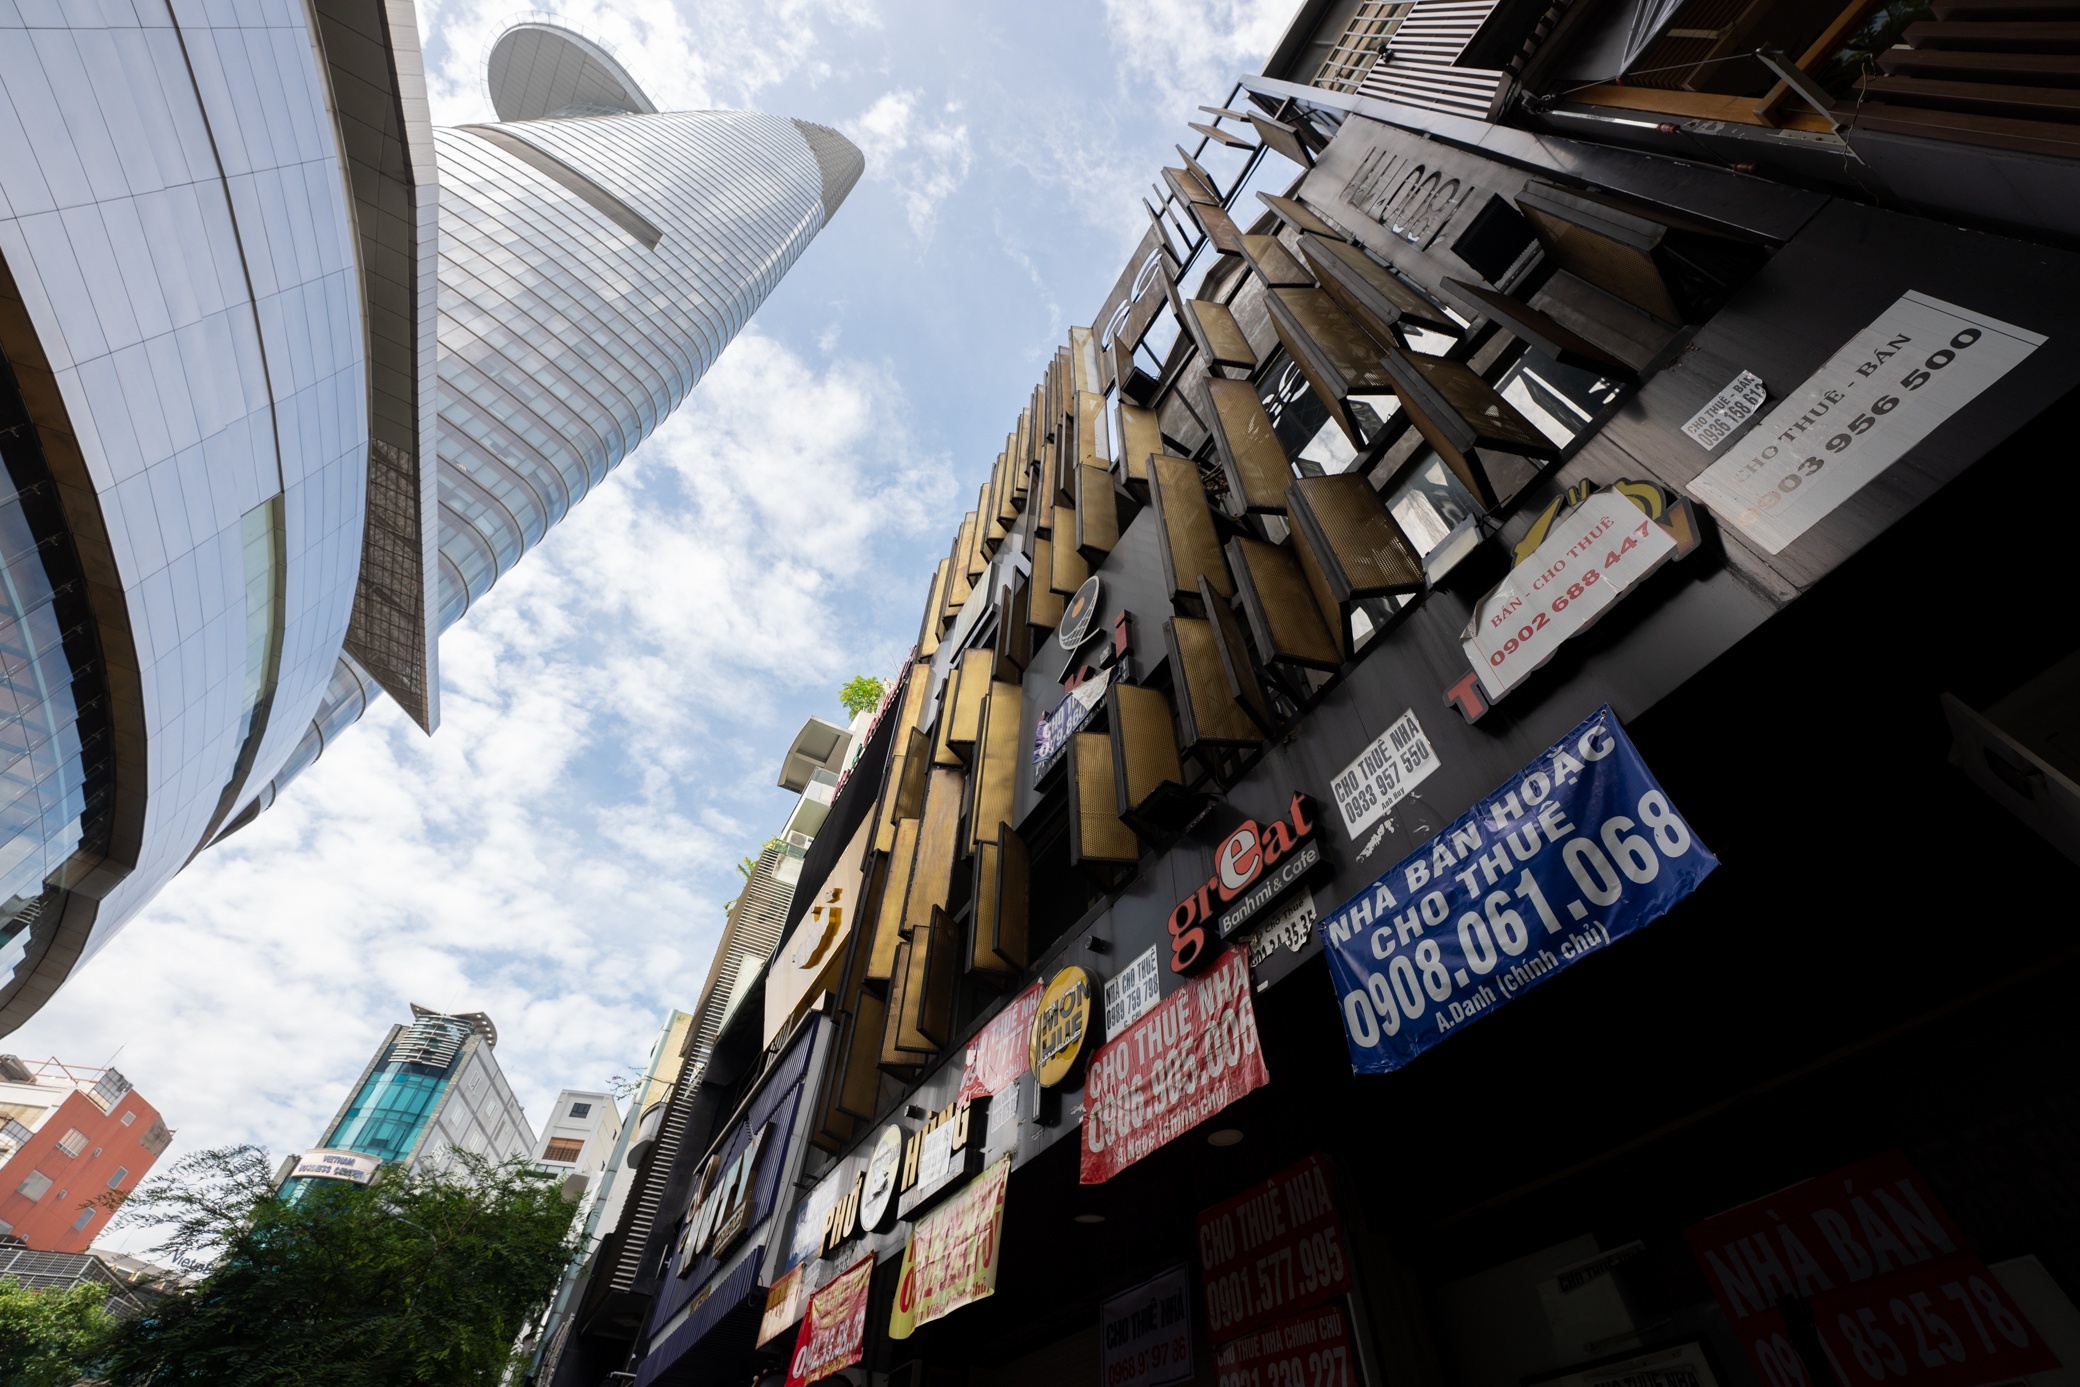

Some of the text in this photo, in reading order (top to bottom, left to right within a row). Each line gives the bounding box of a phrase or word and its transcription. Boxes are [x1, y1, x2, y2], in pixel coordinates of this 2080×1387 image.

[1698, 419, 1731, 446] 0936
[1724, 401, 1751, 423] 168
[1705, 396, 1730, 418] THUÊ
[1735, 445, 1780, 485] CHO
[1777, 390, 1846, 445] THUÊ
[1855, 333, 1913, 380] BÁN
[1738, 327, 1983, 526] 0903 956 500
[1490, 597, 1524, 628] BÁN
[1532, 559, 1567, 591] CHO
[1566, 515, 1615, 559] THUÊ
[1490, 519, 1650, 667] 0902 688 447
[1334, 714, 1420, 804] CHO THUÊ NHÀ
[1344, 738, 1430, 824] 0933 957 550
[1381, 786, 1406, 810] Anh Huy
[1329, 724, 1616, 950] NHÀ BÁN HOẶC
[1370, 800, 1577, 960] CHO THUÊ
[1223, 850, 1317, 933] Banh mi & Cafe
[1265, 899, 1304, 933] Cho Thuê
[1343, 789, 1692, 1049] 0908.061.068
[991, 1003, 1019, 1043] THUÊ
[1090, 949, 1249, 1099] CHO THUÊ NHÀ
[1106, 949, 1157, 1007] NHÀ CHO THUÊ
[1106, 978, 1159, 1031] 0989 759 798
[1436, 920, 1611, 1034] A.Danh (chính chủ)
[1088, 995, 1258, 1153] 0906.905.006
[323, 1155, 356, 1167] VIETNAM
[1199, 1155, 1333, 1271] CHO THUÊ NHÀ
[1704, 1177, 1959, 1320] NHÀ BÁN
[1106, 1286, 1186, 1350] CHO THUÊ NHÀ
[1206, 1225, 1346, 1332] 0901.577.995
[1108, 1355, 1136, 1387] 0968
[1172, 1335, 1187, 1363] 86
[1236, 1332, 1261, 1362] THUÊ
[1261, 1325, 1284, 1356] NHÀ
[1284, 1318, 1318, 1349] CHÍNH
[1318, 1306, 1343, 1341] CHỦ
[1837, 1305, 1908, 1382] 85
[1889, 1290, 1967, 1369] 25
[1939, 1274, 2030, 1354] 78
